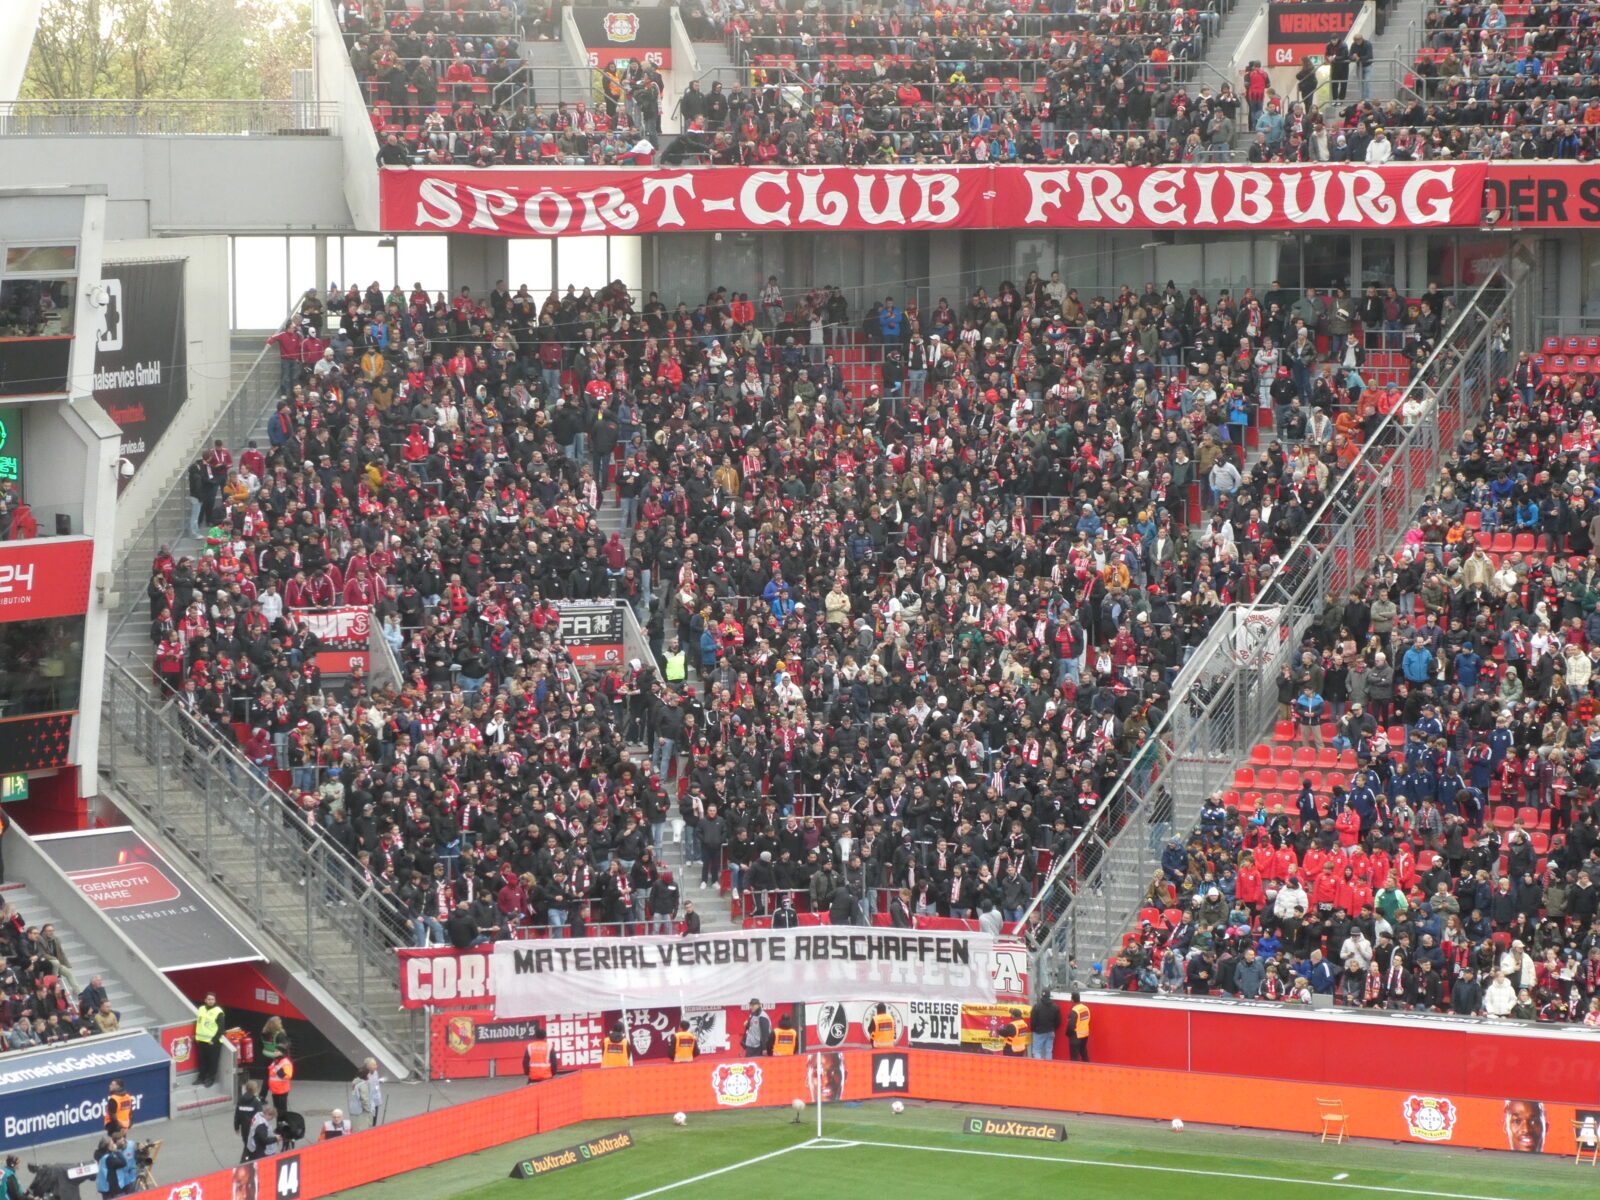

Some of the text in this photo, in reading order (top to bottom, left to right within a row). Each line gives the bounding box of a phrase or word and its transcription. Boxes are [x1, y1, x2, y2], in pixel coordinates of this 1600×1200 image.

[1275, 48, 1293, 63] G4
[415, 166, 1457, 235] SPORT-CLUB FREIBURG
[135, 360, 161, 386] GmbH
[794, 935, 970, 964] ABSCHAFFEN
[910, 1001, 959, 1016] SCHEISS
[478, 1022, 536, 1040] Knaddly's
[546, 1020, 602, 1036] BALL
[929, 1015, 959, 1040] DFL
[875, 1058, 905, 1087] 44
[986, 1120, 1056, 1138] buXtrade
[589, 1133, 631, 1156] buXtrade
[532, 1150, 577, 1173] buXtrade
[277, 1161, 299, 1197] 44
